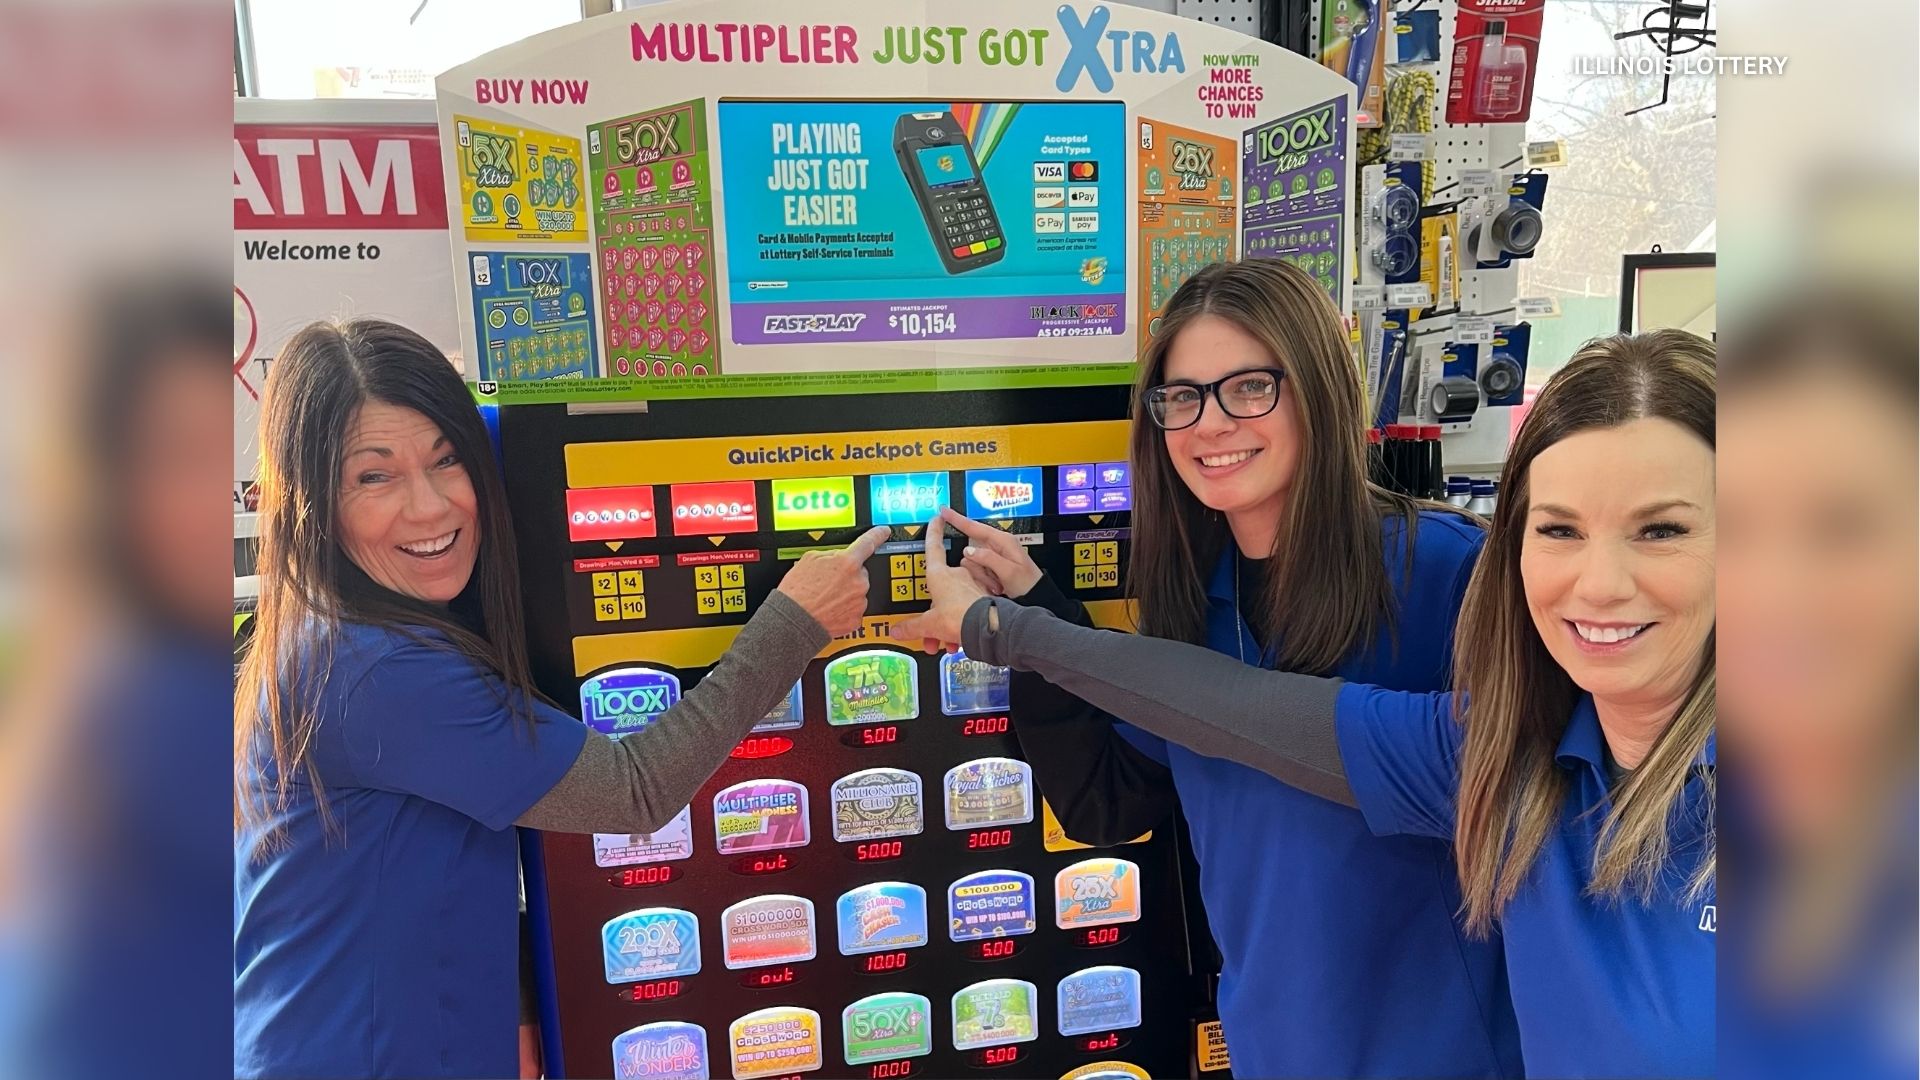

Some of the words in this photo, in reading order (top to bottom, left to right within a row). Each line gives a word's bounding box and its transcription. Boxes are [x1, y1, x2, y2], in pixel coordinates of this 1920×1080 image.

[630, 23, 859, 65] MULTIPLIER
[872, 27, 967, 67] JUST
[978, 28, 1049, 67] GOT
[1055, 4, 1186, 93] XTRA
[1203, 55, 1228, 68] NOW
[1231, 54, 1260, 67] WITH
[1210, 68, 1251, 85] MORE
[475, 79, 523, 104] BUY
[531, 80, 589, 104] NOW
[1198, 86, 1263, 103] CHANCES
[1205, 103, 1226, 119] TO
[1227, 102, 1257, 119] WIN
[616, 113, 680, 163] 50X
[772, 123, 862, 154] PLAYING
[1044, 135, 1088, 144] Accepted
[1259, 109, 1330, 160] 100X
[472, 134, 514, 172] 5X
[635, 148, 661, 166] Xtra
[1041, 146, 1064, 154] Card
[1065, 146, 1091, 155] Types
[1173, 141, 1213, 177] 25X
[1037, 167, 1062, 177] VISA
[1275, 151, 1309, 176] Xtra
[477, 165, 512, 187] Xtra
[768, 160, 822, 191] JUST
[827, 159, 869, 190] GOT
[1179, 173, 1208, 190] Xtra
[1079, 192, 1095, 202] Pay
[784, 195, 857, 226] EASIER
[1485, 199, 1495, 216] Duct
[1037, 218, 1046, 227] G
[1047, 218, 1064, 229] Pay
[1461, 213, 1471, 229] Duct
[758, 234, 779, 244] Card
[780, 234, 787, 243] &
[787, 234, 815, 244] Mobile
[816, 233, 855, 245] Payments
[857, 232, 893, 243] Accepted
[244, 240, 351, 261] Welcome
[356, 242, 380, 260] to
[760, 250, 769, 260] at
[770, 249, 801, 261] Lottery
[802, 248, 852, 259] Self-Service
[853, 247, 893, 258] Terminals
[478, 274, 488, 283] $2
[518, 260, 561, 286] 10X
[534, 285, 561, 298] Xtra
[766, 318, 807, 331] FAST
[816, 316, 862, 329] PLAY
[889, 313, 956, 338] $10,154
[1037, 329, 1052, 337] AS
[1053, 328, 1066, 337] OF
[1068, 328, 1094, 336] 09:23
[1095, 327, 1112, 335] AM
[1370, 355, 1379, 369] Tire
[480, 384, 495, 392] 18+
[728, 445, 835, 465] QuickPick
[840, 439, 923, 461] Jackpot
[929, 438, 997, 455] Games
[995, 484, 1030, 500] MEGA
[777, 491, 849, 511] Lotto
[1080, 550, 1090, 559] $2
[1102, 548, 1113, 558] $5
[896, 561, 907, 571] $1
[598, 578, 611, 590] $2
[624, 577, 637, 588] $4
[700, 572, 713, 584] $3
[726, 570, 738, 582] $6
[1077, 572, 1094, 583] $10
[1099, 571, 1116, 581] $30
[896, 585, 908, 595] $3
[601, 603, 614, 615] $6
[624, 602, 643, 613] $10
[703, 597, 715, 607] $9
[725, 595, 743, 606] $15
[594, 688, 666, 715] 100X
[964, 717, 1008, 735] 20.00
[864, 727, 896, 744] 5.00
[837, 783, 917, 799] MILLIONAIRE
[752, 805, 797, 817] MADNESS
[861, 798, 893, 809] CLUB
[969, 830, 1011, 848] 30.00
[858, 841, 902, 860] 50.00
[754, 854, 788, 871] out
[623, 866, 671, 885] 30.00
[963, 883, 1015, 895] $100,000
[1072, 876, 1118, 902] 25X
[1081, 898, 1112, 914] Xtra
[965, 915, 979, 924] WIN
[979, 914, 988, 923] UP
[988, 913, 997, 922] TO
[619, 919, 681, 954] 200X
[731, 922, 788, 936] CROSSWORD
[1088, 927, 1119, 945] 5.00
[732, 936, 747, 944] WIN
[983, 940, 1014, 957] 5.00
[868, 953, 906, 971] 10.00
[761, 967, 793, 984] out
[634, 981, 679, 1000] 30.00
[854, 1007, 910, 1038] 50X
[628, 1034, 696, 1066] Winter
[737, 1053, 754, 1062] WIN
[755, 1052, 765, 1060] UP
[766, 1051, 775, 1059] TO
[986, 1047, 1017, 1064] 5.00
[620, 1056, 701, 1078] WONDERS
[873, 1061, 910, 1079] 10.00
